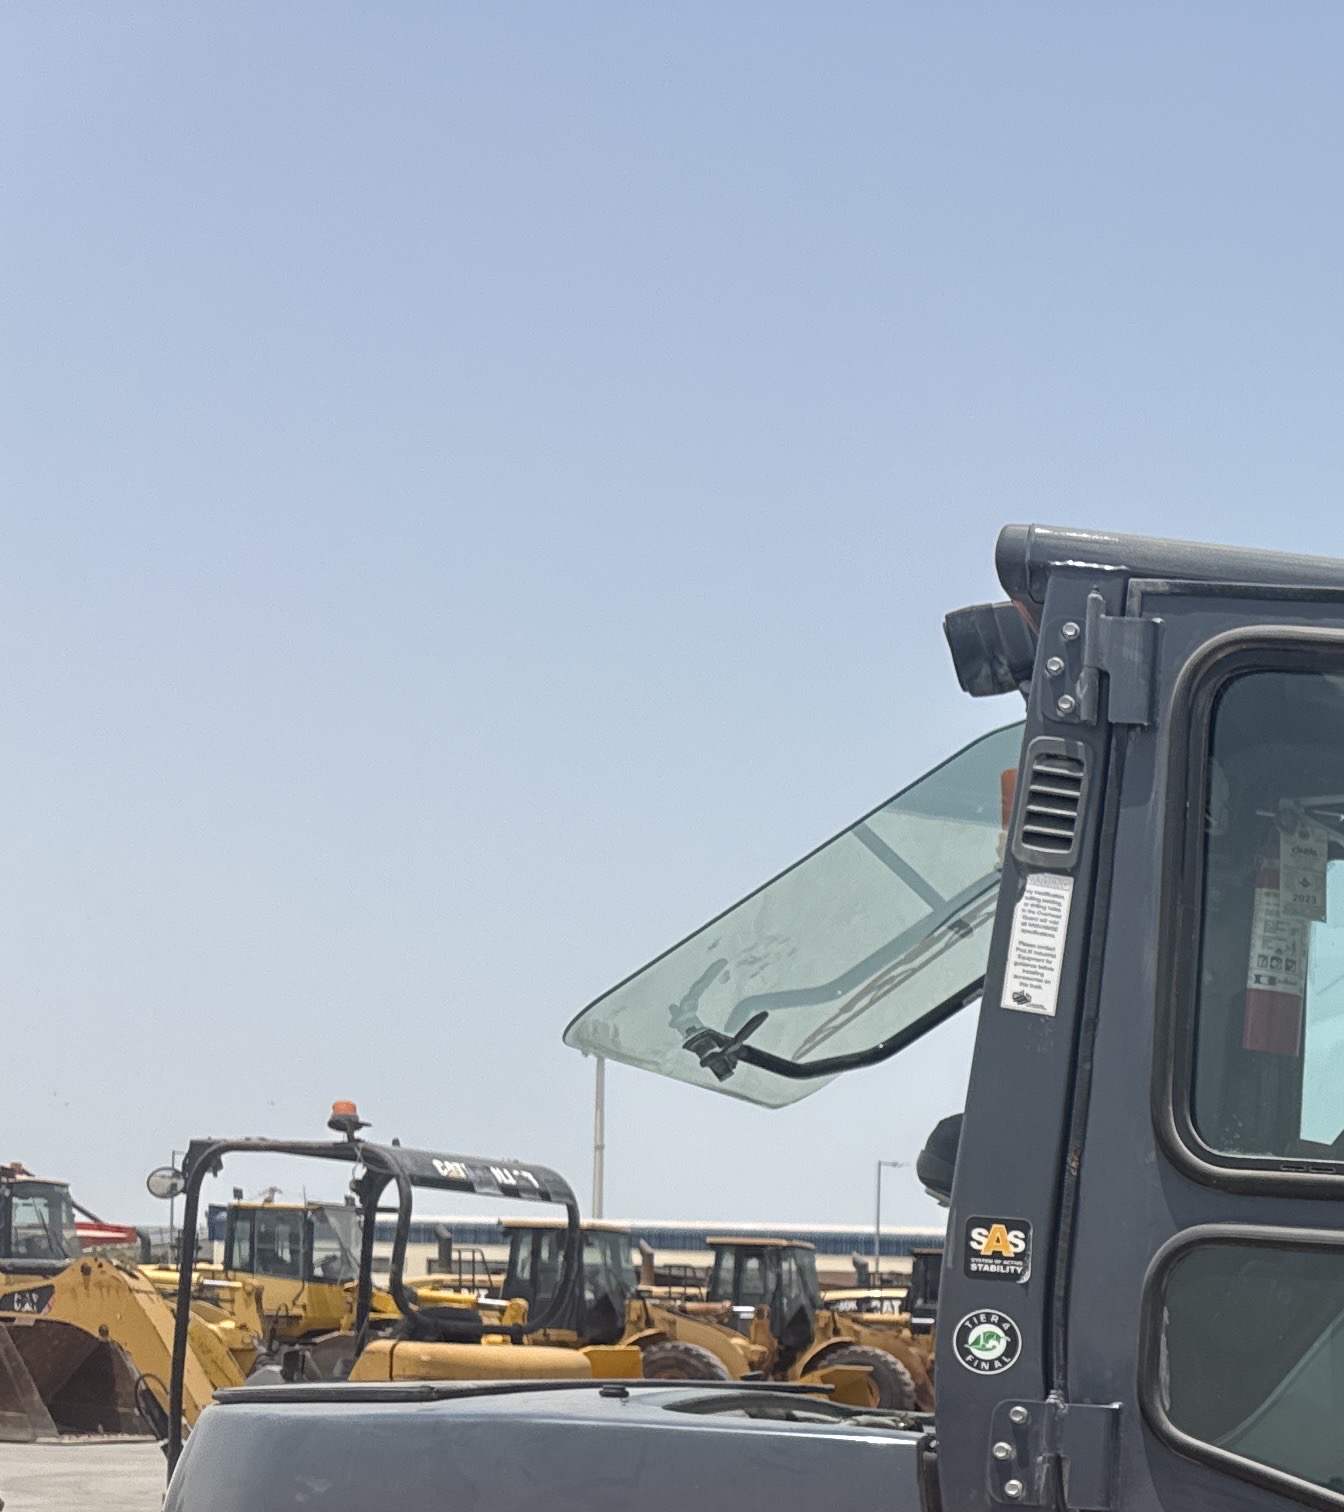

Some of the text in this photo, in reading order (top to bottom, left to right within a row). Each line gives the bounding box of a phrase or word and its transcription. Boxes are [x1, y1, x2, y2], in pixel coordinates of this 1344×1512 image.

[969, 1223, 1026, 1257] SAS
[970, 1263, 1022, 1274] STABILITY
[964, 1313, 1011, 1331] TIER 4
[965, 1354, 1012, 1370] FINAL
